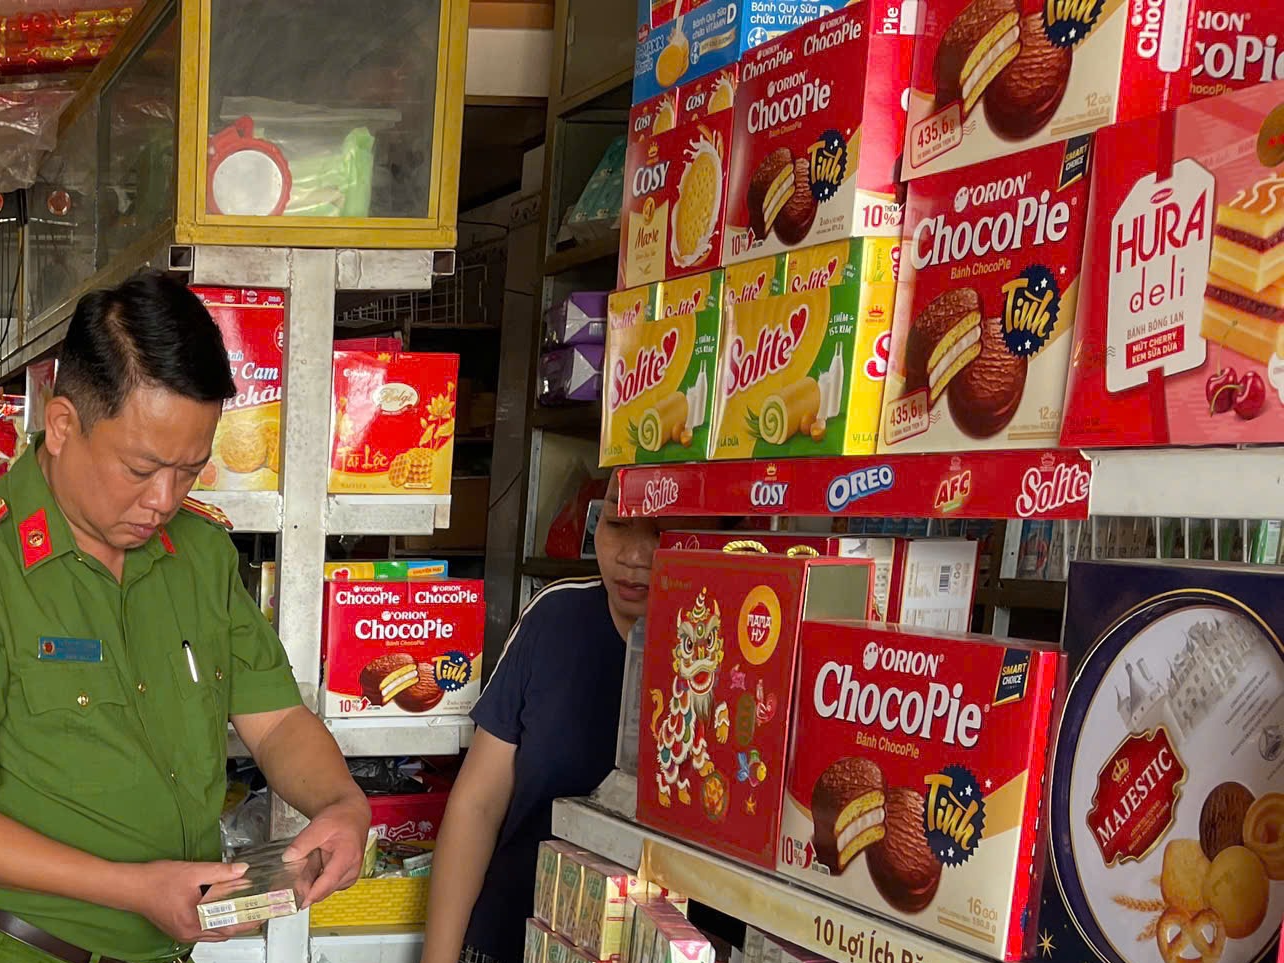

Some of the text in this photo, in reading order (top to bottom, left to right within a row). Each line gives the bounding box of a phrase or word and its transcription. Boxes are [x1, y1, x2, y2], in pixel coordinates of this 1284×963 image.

[751, 14, 776, 25] chứa
[779, 3, 797, 14] Quy
[884, 7, 897, 34] Pie
[803, 19, 861, 57] ChocoPie
[775, 71, 806, 92] ORION
[747, 78, 831, 134] ChocoPie
[972, 174, 1027, 205] ORION
[913, 190, 1070, 270] ChocoPie
[1116, 188, 1207, 273] HURA
[951, 259, 1011, 280] Bánh ChocoPie
[1130, 255, 1184, 313] deli
[1127, 311, 1185, 340] BÁNH BÔNG LAN
[1149, 332, 1178, 349] CHERRY
[242, 363, 278, 381] Cam
[726, 326, 790, 396] Solite
[1132, 352, 1146, 365] KEM
[612, 349, 665, 410] Solite
[642, 475, 679, 516] Solite
[828, 466, 894, 511] OREO
[935, 469, 971, 510] AFC
[1017, 462, 1090, 518] Solite
[335, 591, 400, 605] ChocoPie
[415, 590, 478, 604] ChocoPie
[355, 618, 454, 641] ChocoPie
[392, 611, 427, 621] ORION
[881, 647, 939, 678] ORION
[1002, 662, 1027, 676] SMART
[1002, 674, 1022, 686] CHOICE
[814, 661, 982, 748] ChocoPie
[856, 731, 920, 759] Bánh ChocoPie
[1097, 747, 1173, 847] MAJESTIC
[968, 897, 982, 915] 16
[814, 915, 835, 946] 10
[838, 933, 865, 963] Lợi
